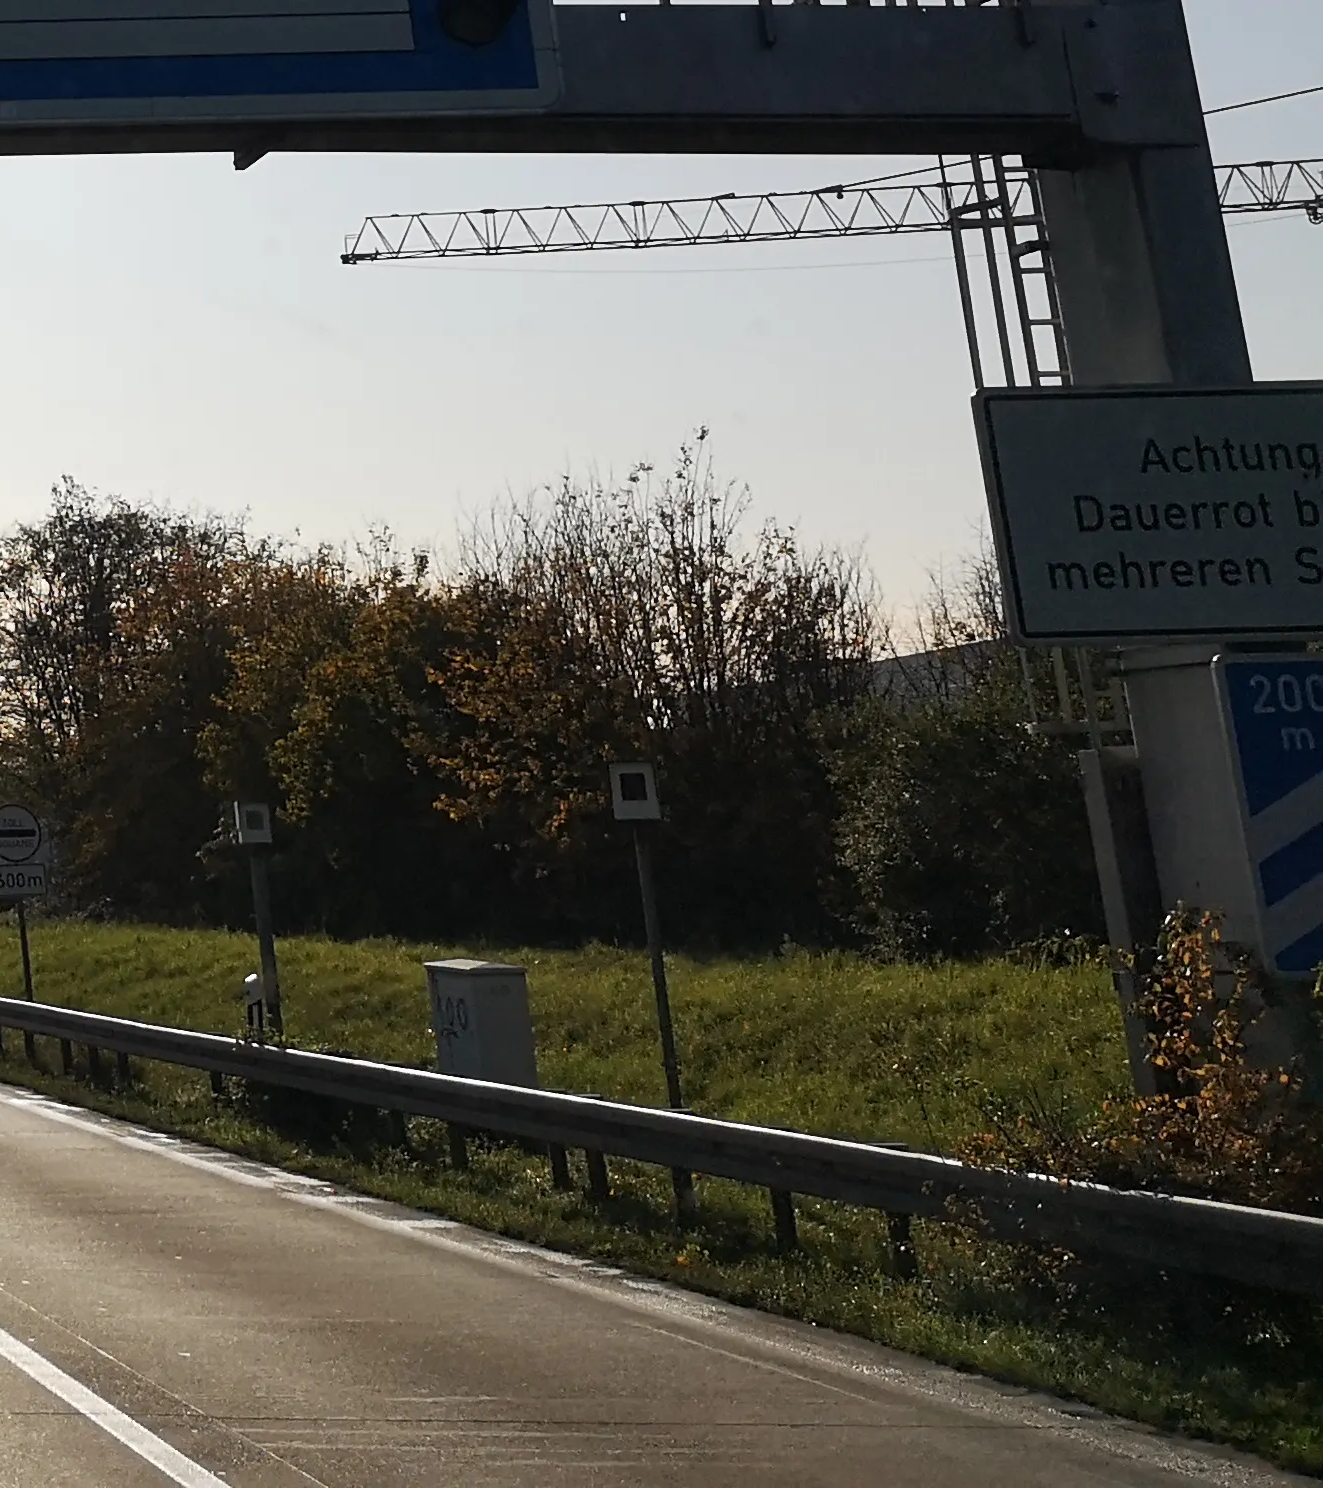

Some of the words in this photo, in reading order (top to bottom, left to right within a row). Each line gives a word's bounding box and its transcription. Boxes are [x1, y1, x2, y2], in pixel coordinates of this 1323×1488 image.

[1140, 435, 1322, 479] Achtung
[1072, 493, 1275, 532] Dauerrot
[1046, 551, 1273, 591] mehreren
[1281, 727, 1316, 750] m
